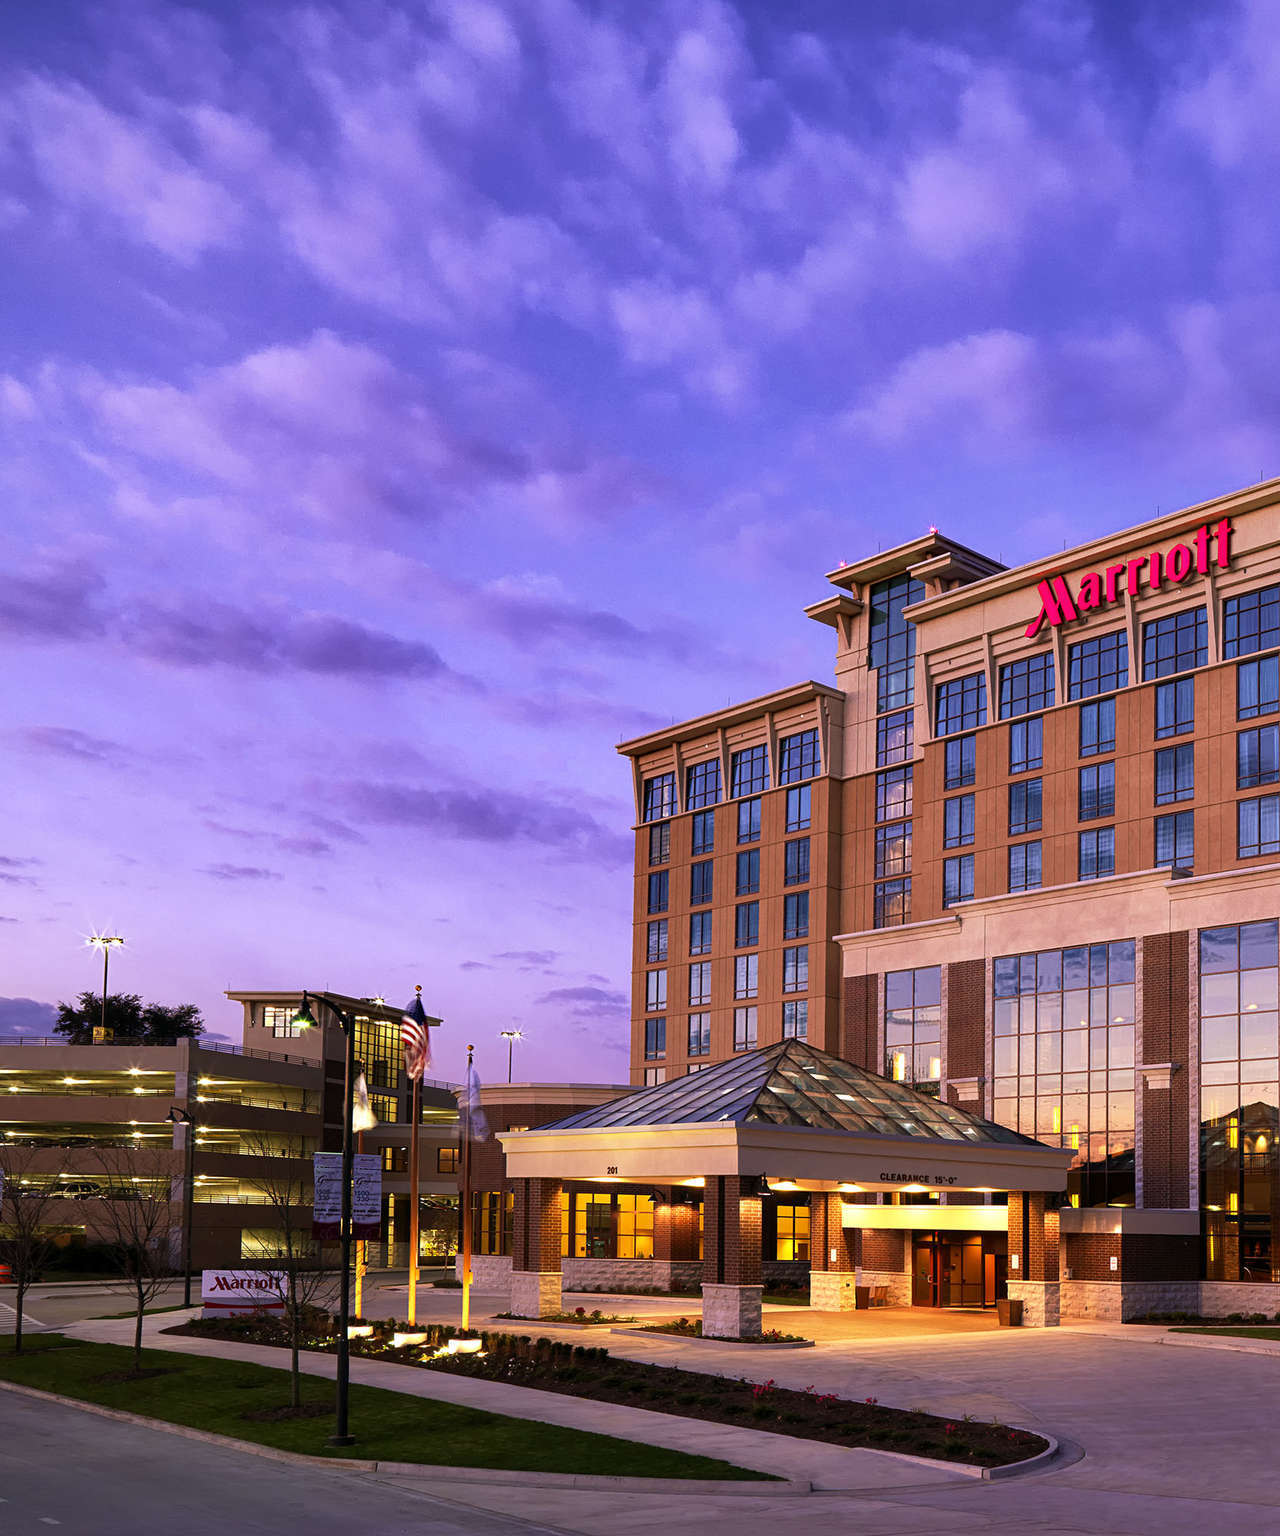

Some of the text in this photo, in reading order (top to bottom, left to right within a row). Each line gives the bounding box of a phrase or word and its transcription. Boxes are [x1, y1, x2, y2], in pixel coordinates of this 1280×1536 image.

[1024, 517, 1234, 639] Marriott
[607, 1166, 618, 1175] 201
[880, 1172, 930, 1184] CLEARANCE
